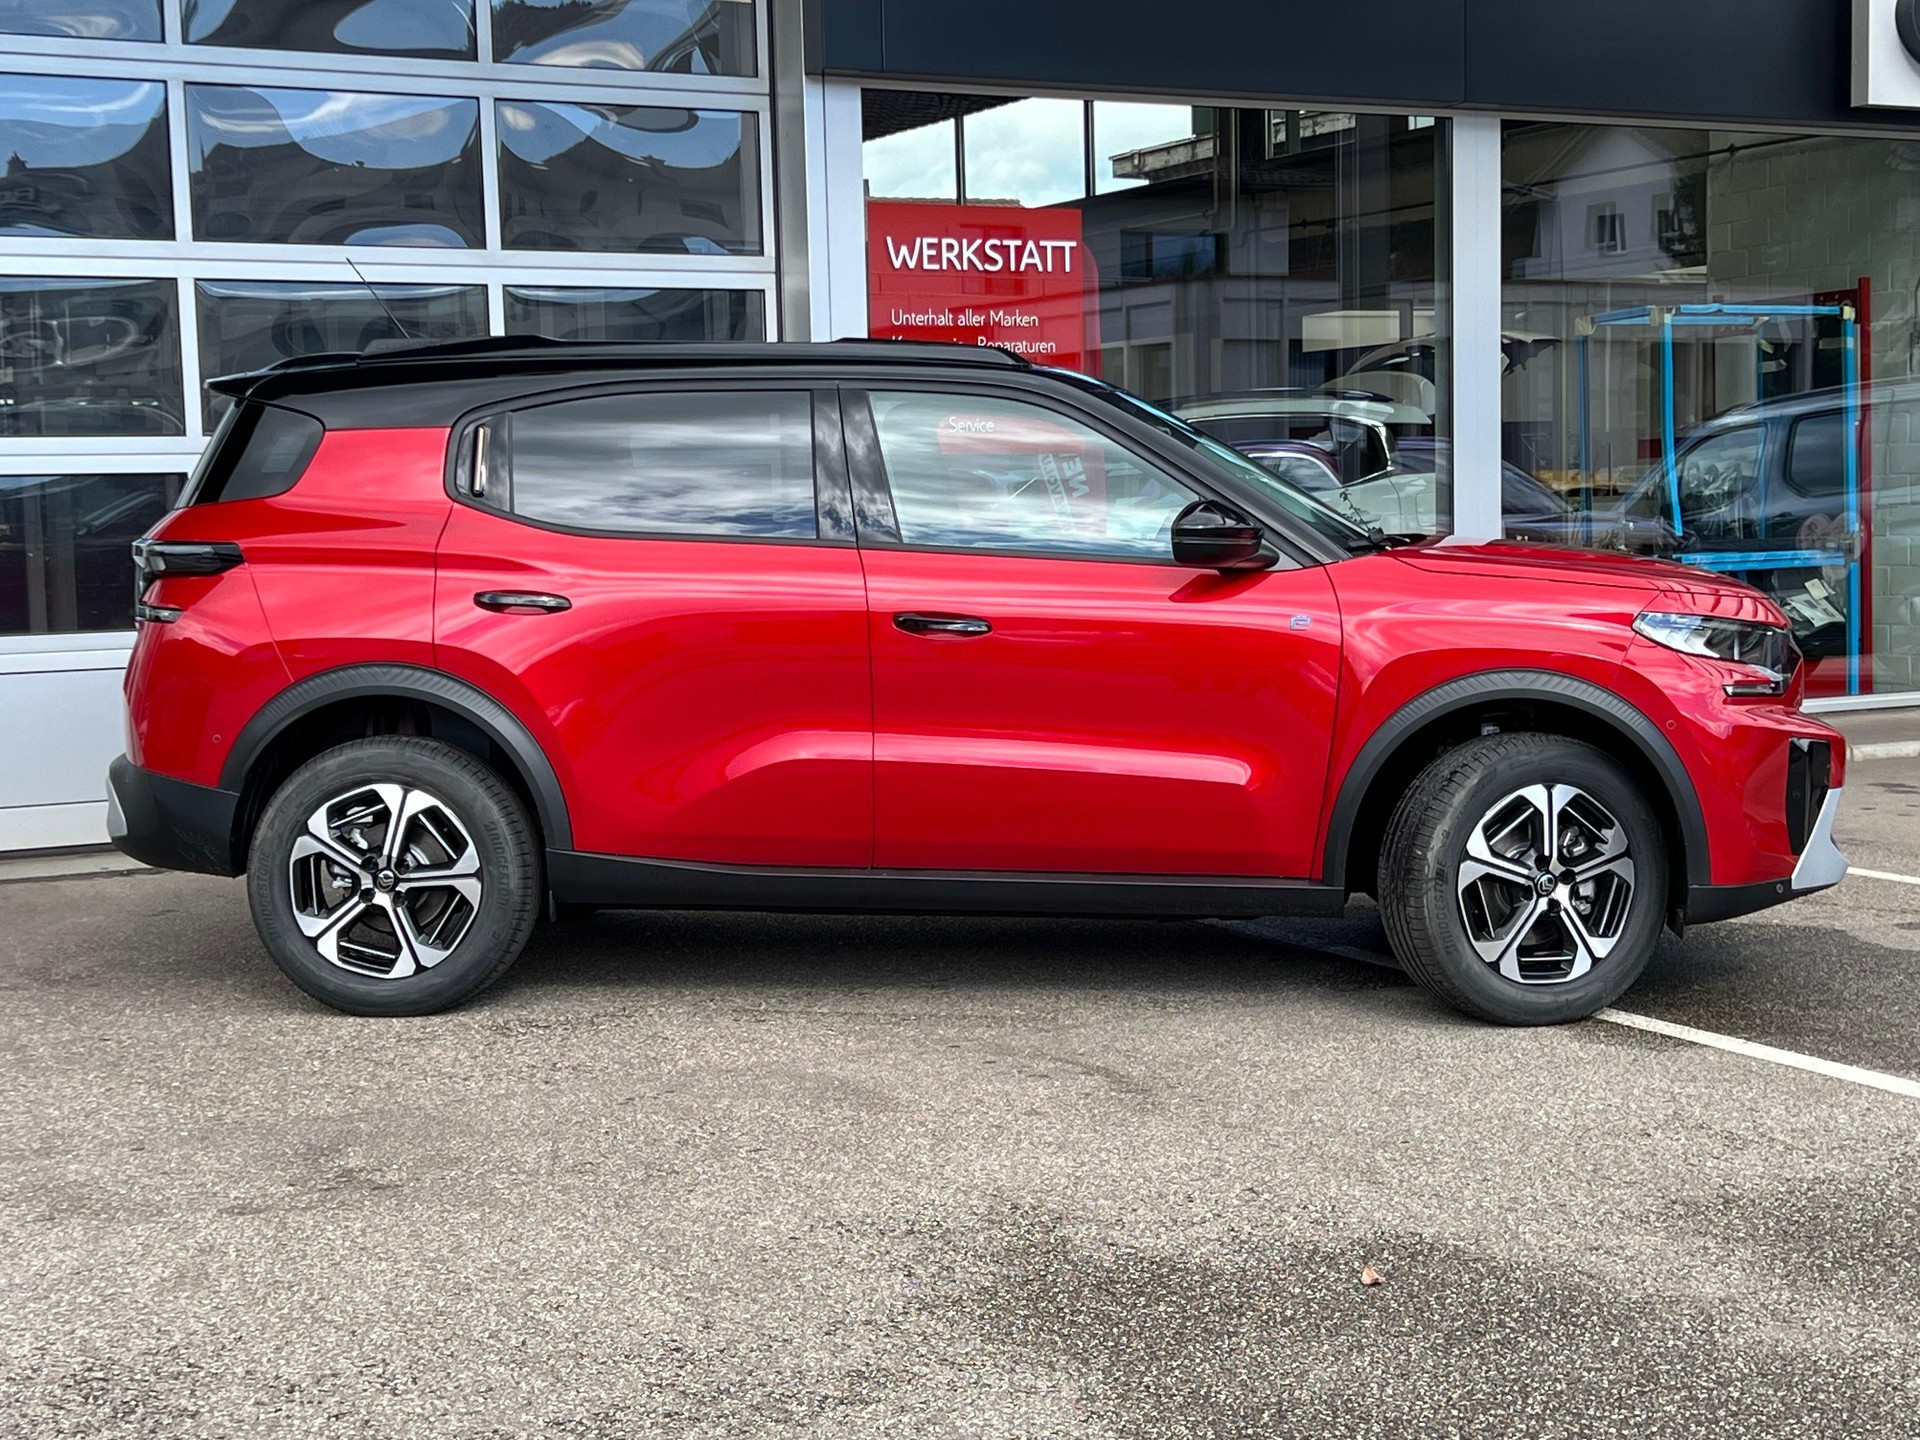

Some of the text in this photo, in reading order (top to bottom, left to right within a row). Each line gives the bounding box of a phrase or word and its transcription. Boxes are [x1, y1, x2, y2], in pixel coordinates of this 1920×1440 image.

[886, 235, 1077, 273] WERKSTATT
[891, 308, 1039, 328] Unterhalt aller Marken
[948, 416, 995, 433] Service
